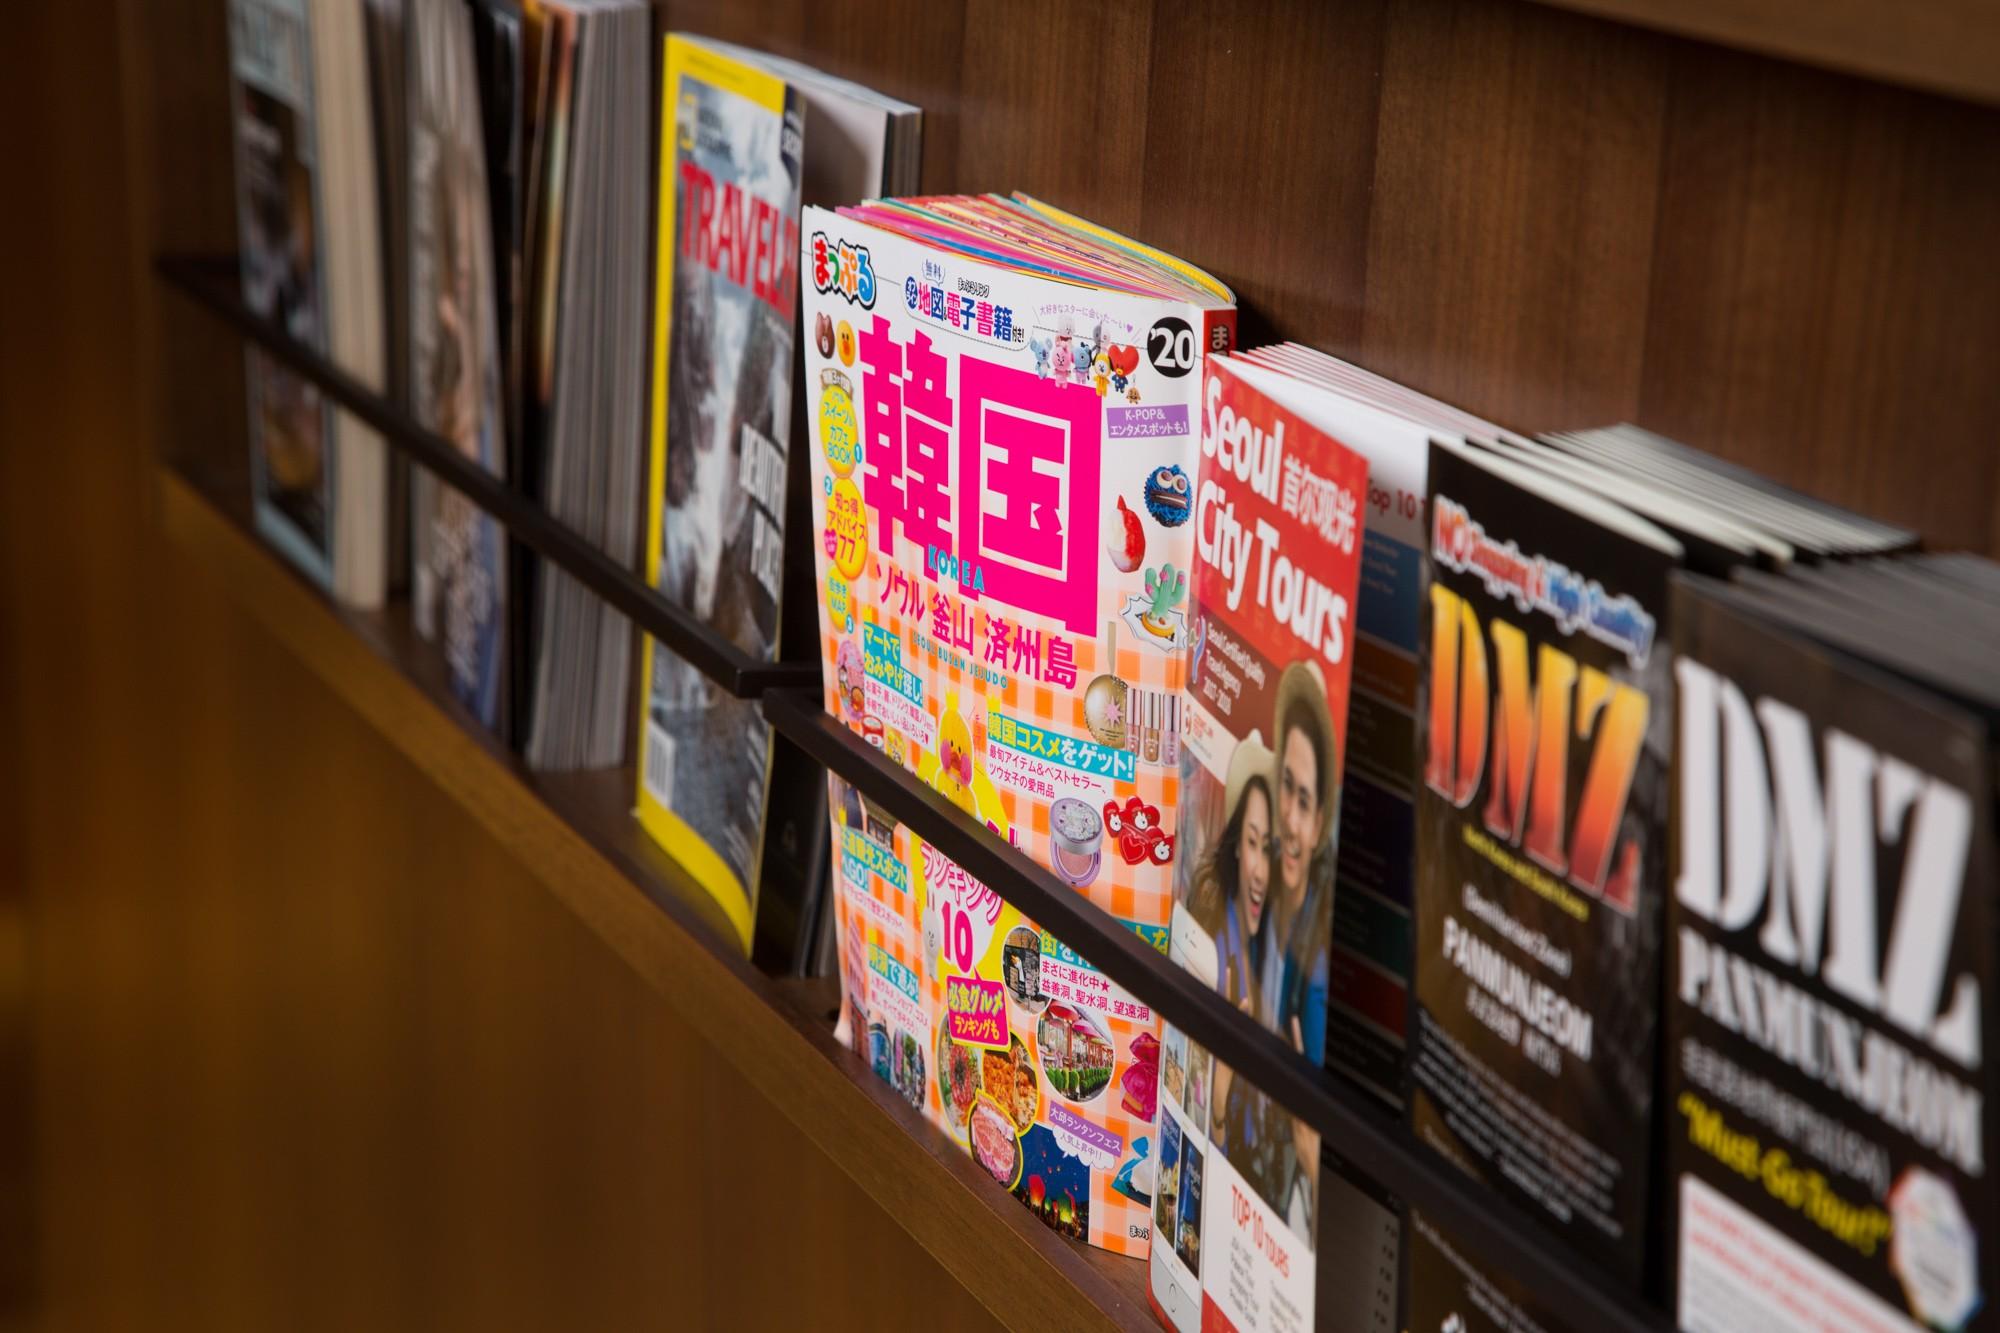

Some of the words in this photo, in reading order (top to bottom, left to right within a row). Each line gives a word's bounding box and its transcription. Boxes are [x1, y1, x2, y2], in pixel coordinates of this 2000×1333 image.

[814, 235, 875, 307] まっぷる
[1110, 420, 1188, 436] エンタメスポットも!
[1125, 407, 1166, 421] K-POP&
[1202, 376, 1285, 505] Seoul
[858, 313, 1102, 637] 韓国
[838, 534, 856, 564] 77
[927, 543, 985, 594] KOREA
[1197, 480, 1253, 612] City
[1255, 519, 1348, 665] Tours
[876, 562, 926, 624] ソウル
[932, 591, 974, 657] 釜山
[983, 613, 1078, 692] 済州島
[937, 646, 966, 672] BUSAN
[969, 662, 1008, 690] JEJUDO
[988, 712, 1134, 779] 韓国コスメをゲット!
[1424, 580, 1652, 918] DMZ
[989, 762, 1055, 799] ツウ女子の愛用品
[1673, 654, 1983, 1070] DMZ
[941, 900, 973, 974] 10
[954, 1014, 1000, 1041] ランキングも
[1231, 1183, 1250, 1231] TOP
[1252, 1209, 1264, 1249] 10
